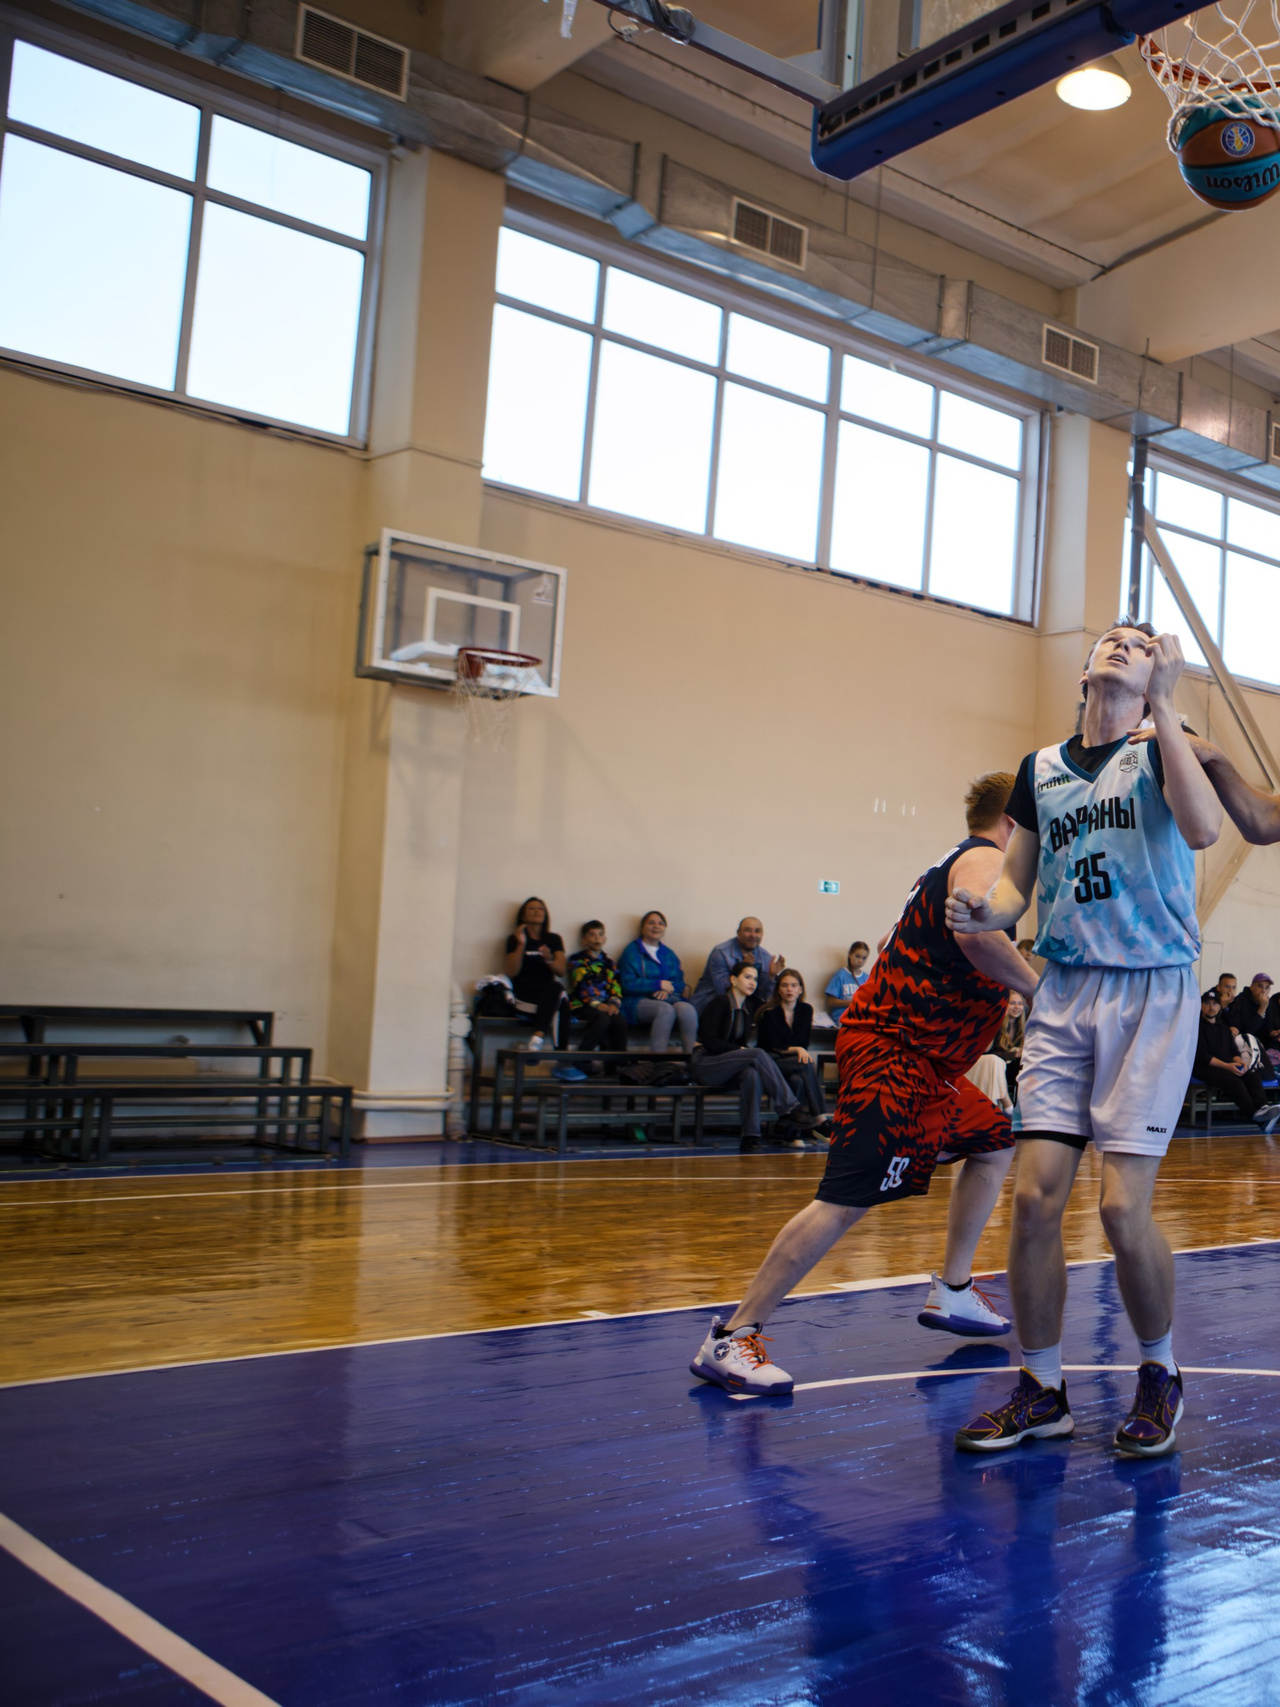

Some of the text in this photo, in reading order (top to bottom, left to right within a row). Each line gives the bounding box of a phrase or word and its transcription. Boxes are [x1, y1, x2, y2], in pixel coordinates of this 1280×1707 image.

[1205, 162, 1280, 193] Wilson
[1037, 773, 1071, 794] fruitit
[1050, 797, 1136, 853] ВАРАНЫ
[1074, 852, 1112, 904] 35
[1146, 1125, 1167, 1134] MAXX
[880, 1156, 910, 1191] 58
